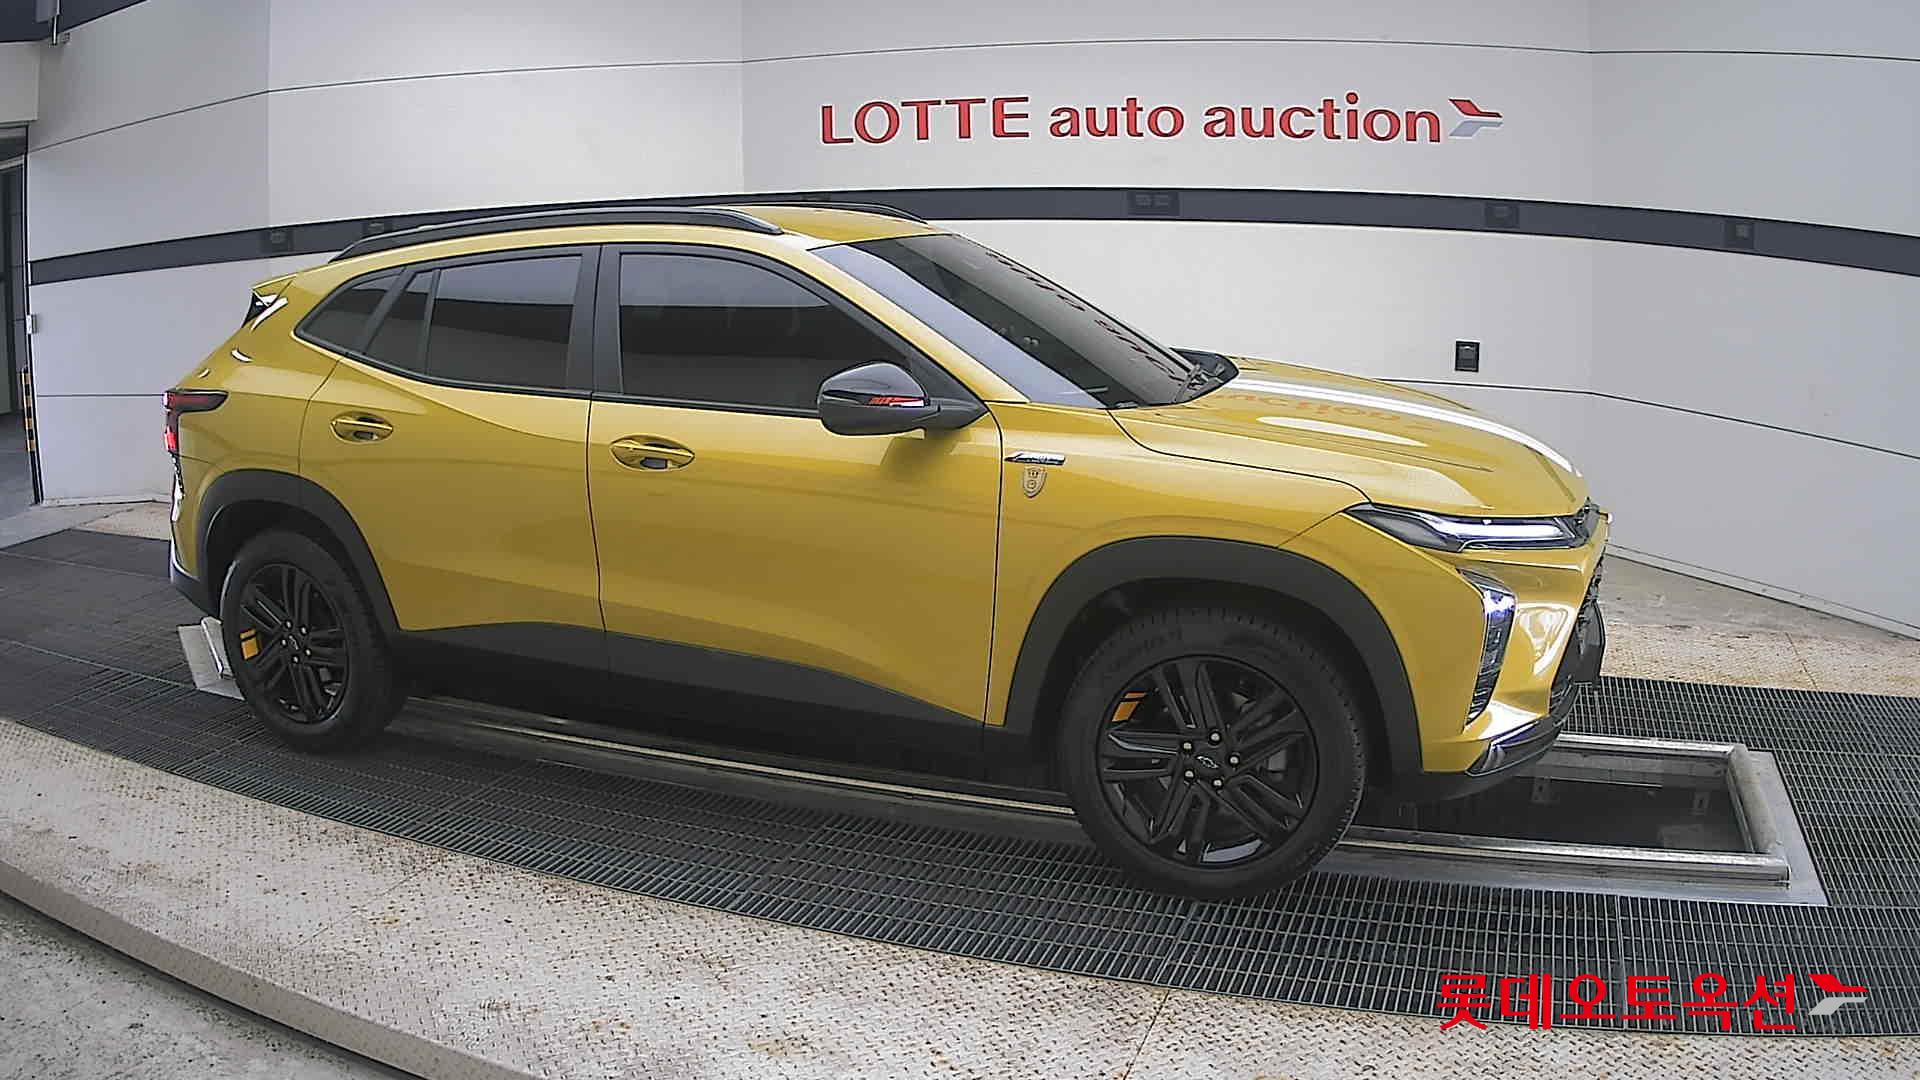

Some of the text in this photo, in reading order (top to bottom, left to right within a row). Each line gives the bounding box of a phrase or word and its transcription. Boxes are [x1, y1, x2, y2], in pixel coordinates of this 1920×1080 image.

[820, 92, 1442, 144] LOTTE auto auction
